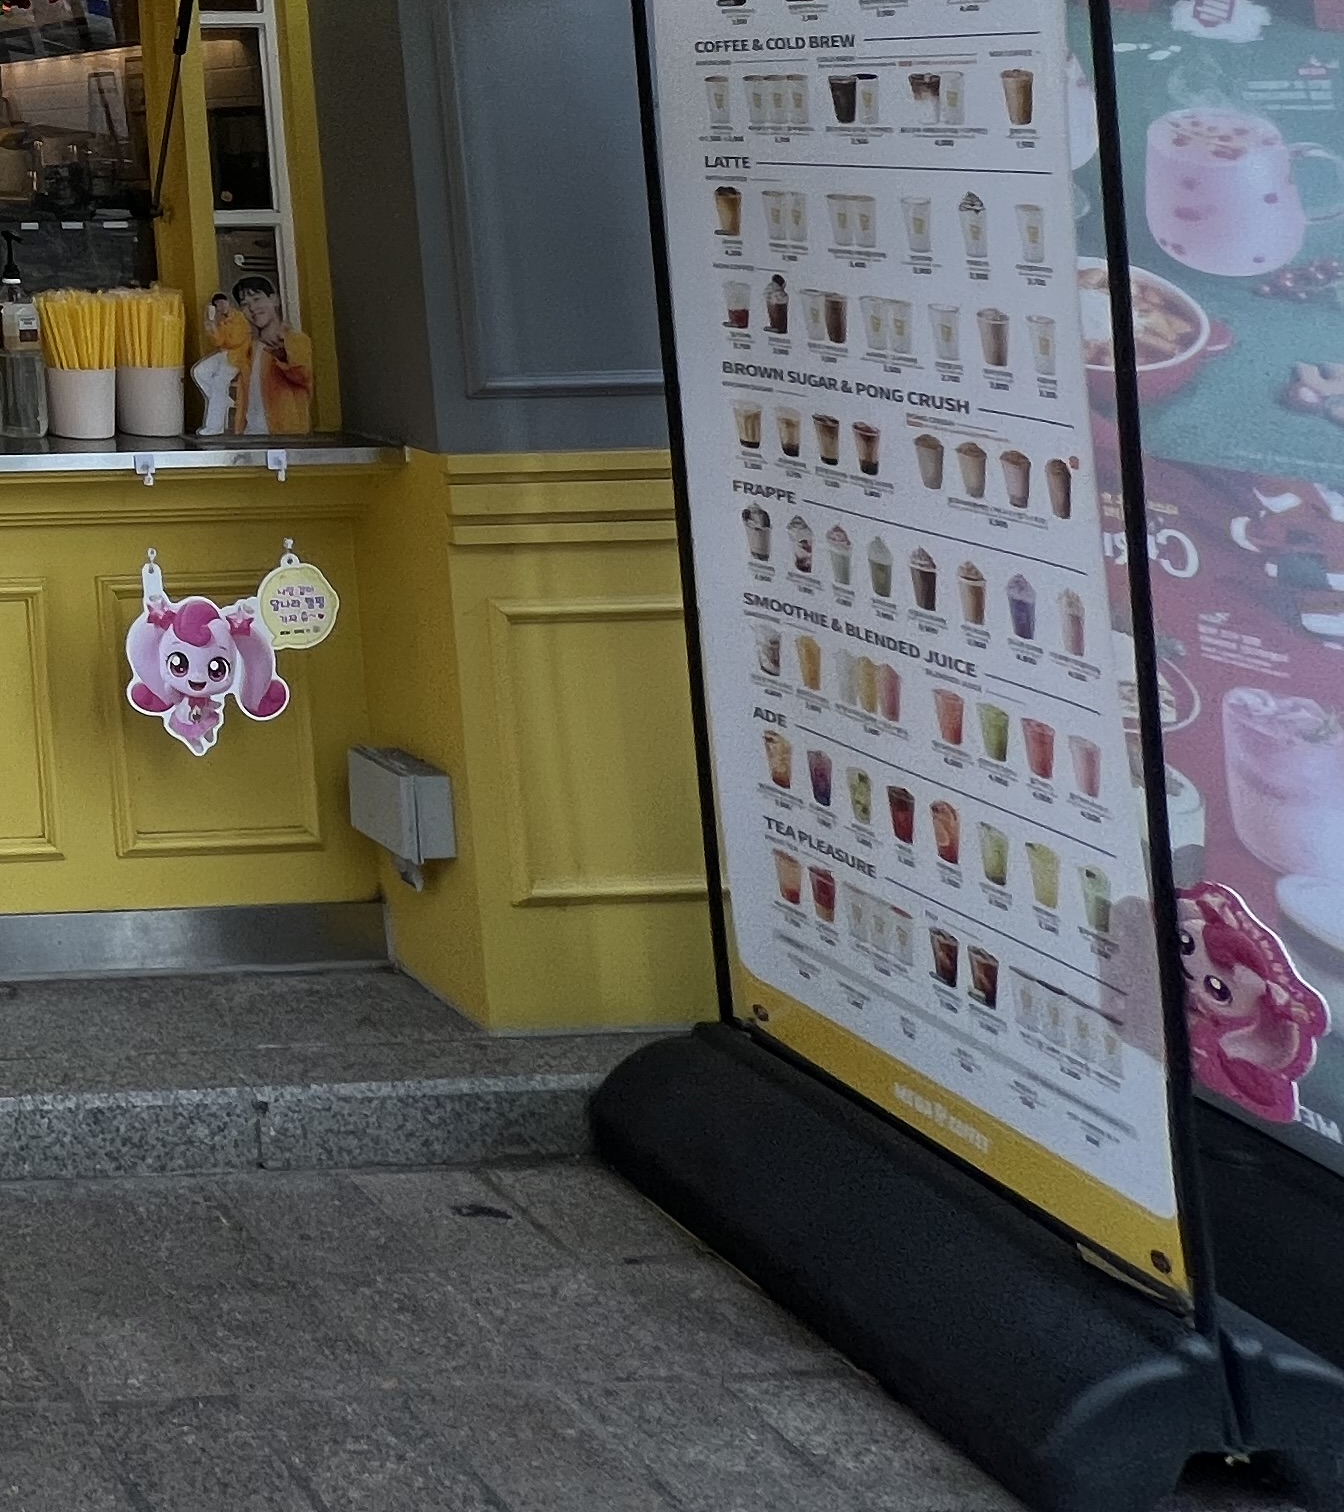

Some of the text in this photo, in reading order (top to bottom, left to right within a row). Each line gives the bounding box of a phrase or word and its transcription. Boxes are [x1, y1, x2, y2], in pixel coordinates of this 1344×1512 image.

[693, 38, 750, 55] COFFEE
[765, 35, 806, 51] COLD
[808, 33, 856, 50] BREW
[704, 154, 751, 171] LATTE
[721, 360, 786, 386] BROWN
[786, 368, 838, 391] SUGAR
[855, 381, 904, 403] PONG
[906, 390, 970, 415] CRUSH
[732, 479, 797, 505] FRAPPE
[742, 591, 829, 631] SMOOTHIE
[844, 619, 921, 659] BLENDED
[924, 647, 977, 679] JUICE
[752, 705, 788, 730] ADE
[762, 814, 877, 880] TEA PLEASURE
